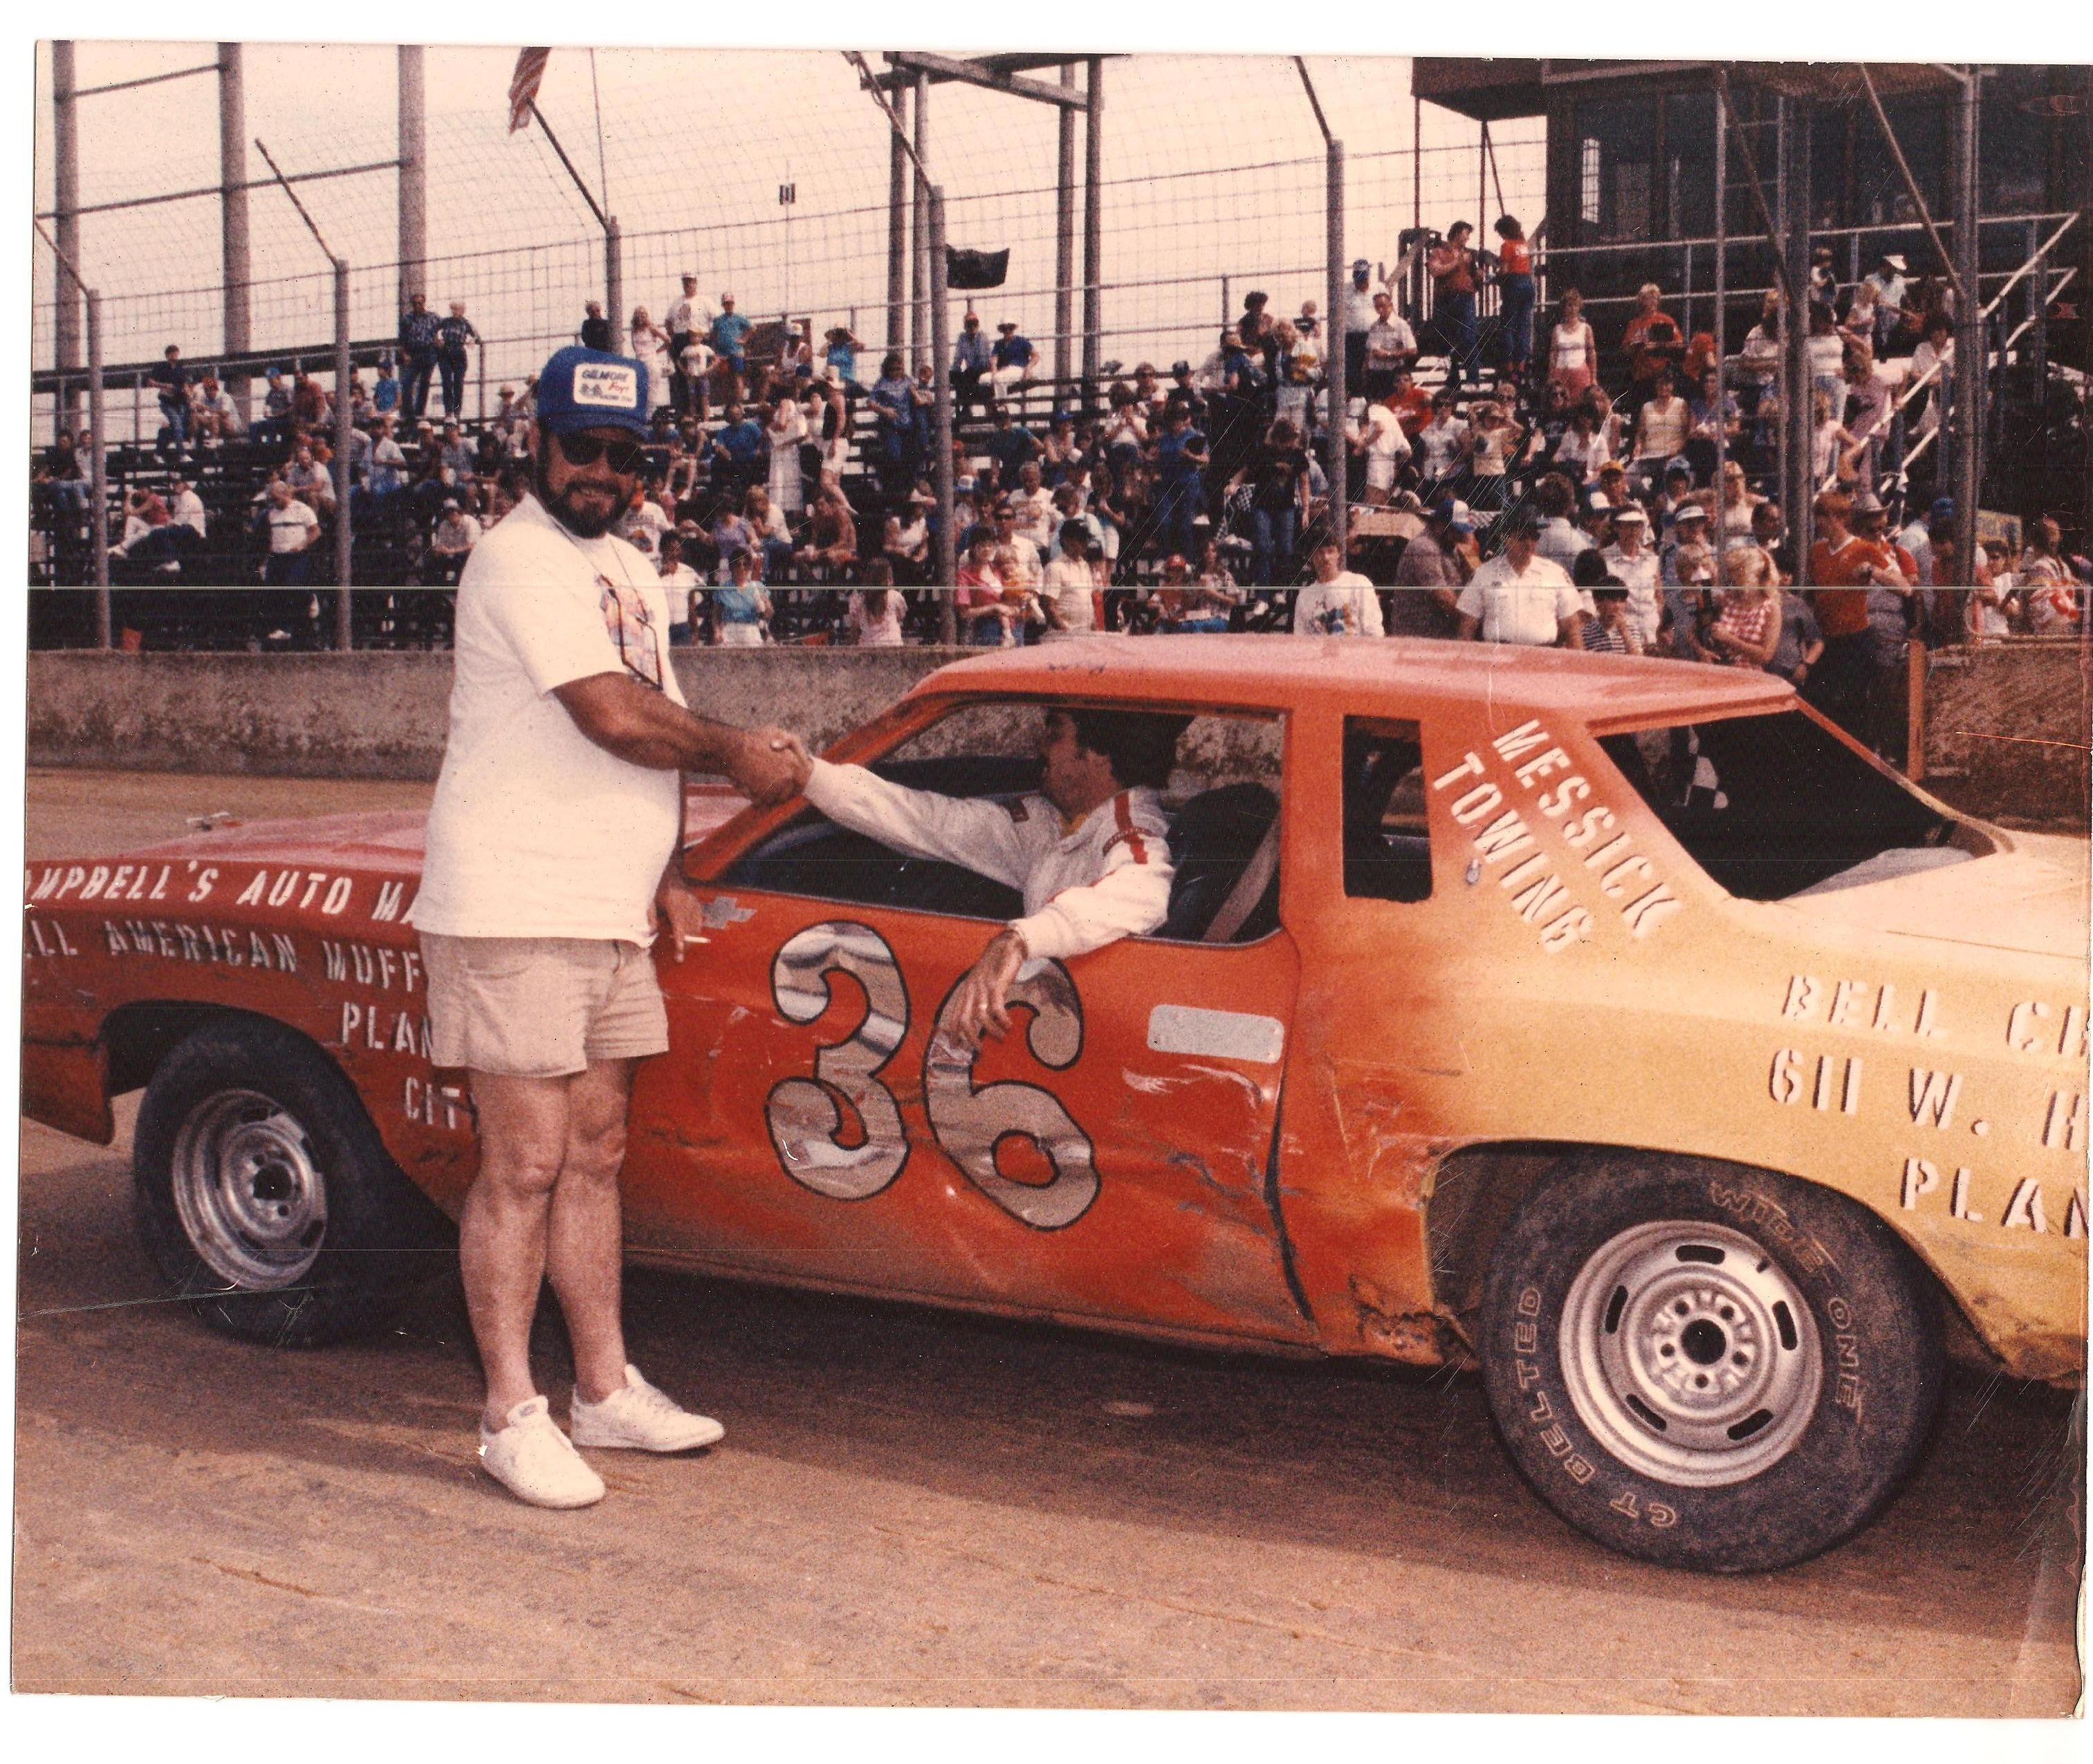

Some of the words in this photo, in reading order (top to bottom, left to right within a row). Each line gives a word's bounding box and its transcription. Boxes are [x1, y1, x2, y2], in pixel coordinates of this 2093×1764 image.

[1433, 751, 1594, 955] TOWING
[1492, 719, 1683, 939] MESSICK
[237, 870, 352, 915] AUTO
[25, 919, 78, 958] LL
[104, 920, 297, 972] AMERICAN
[322, 940, 419, 992] MUFF
[1782, 975, 1950, 1038] BELL
[406, 1076, 477, 1130] CIT
[764, 919, 1102, 1231] 36
[1769, 1047, 1863, 1116] 611
[1908, 1067, 1991, 1136] W.
[1515, 1287, 1595, 1485] BELTED
